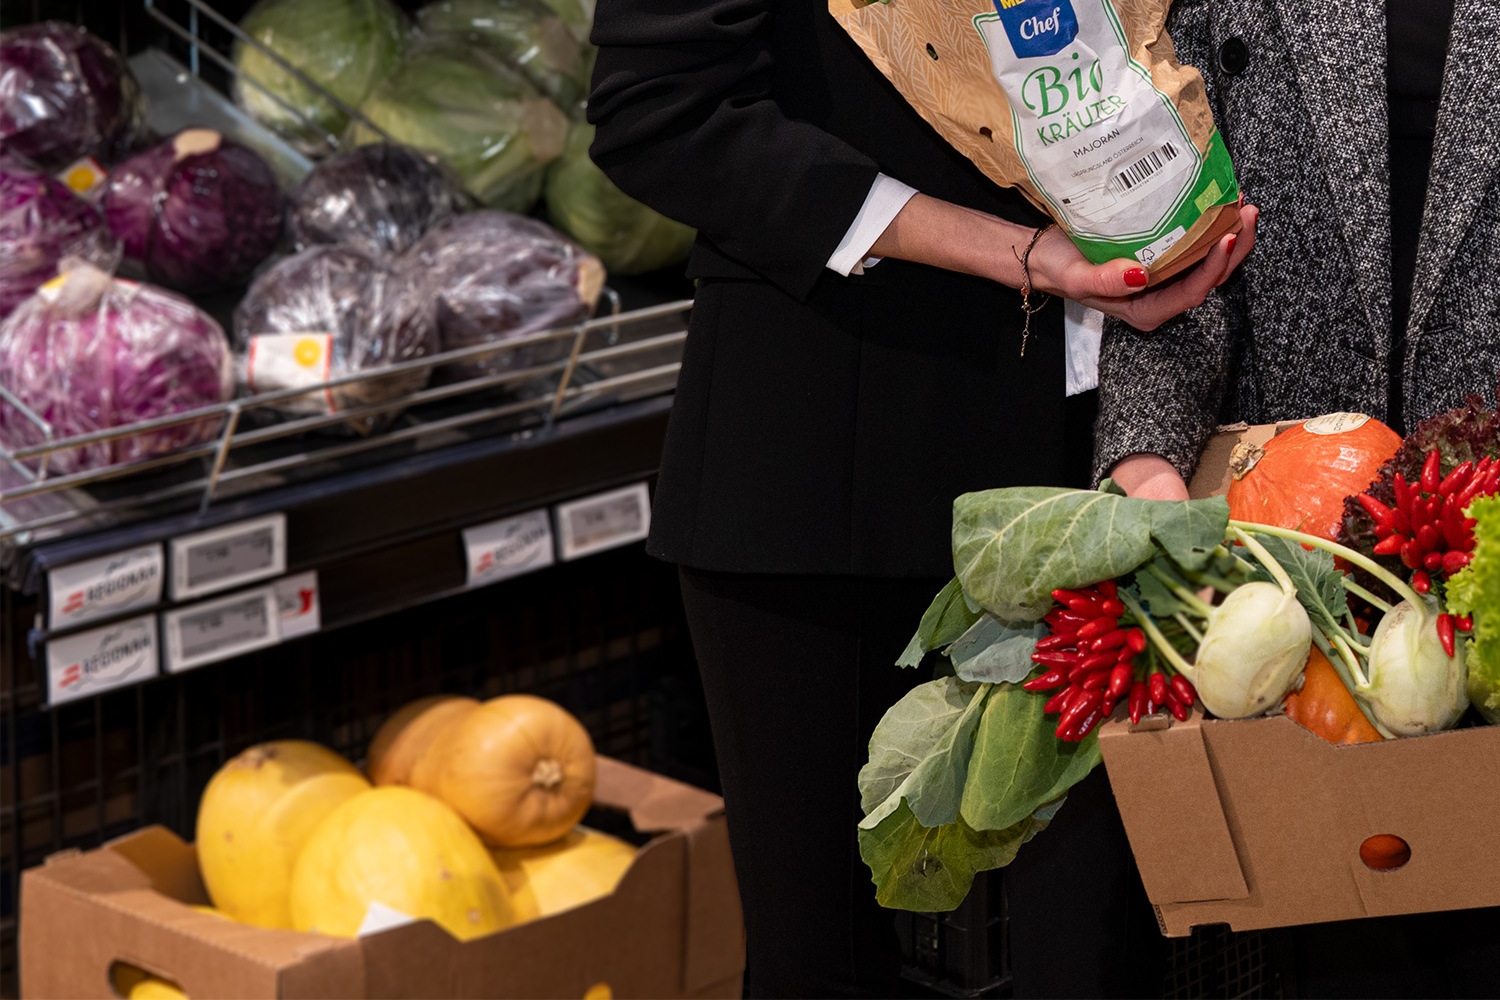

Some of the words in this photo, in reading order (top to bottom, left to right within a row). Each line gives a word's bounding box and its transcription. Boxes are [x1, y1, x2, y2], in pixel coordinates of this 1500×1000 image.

[1020, 7, 1061, 40] Chef
[1021, 52, 1103, 119] Bio
[1036, 94, 1127, 147] KRÄUTER
[1071, 155, 1113, 179] URSPRUNGSLAND
[1113, 136, 1144, 159] ÖSTERREICH
[1073, 128, 1120, 158] MAJORAN
